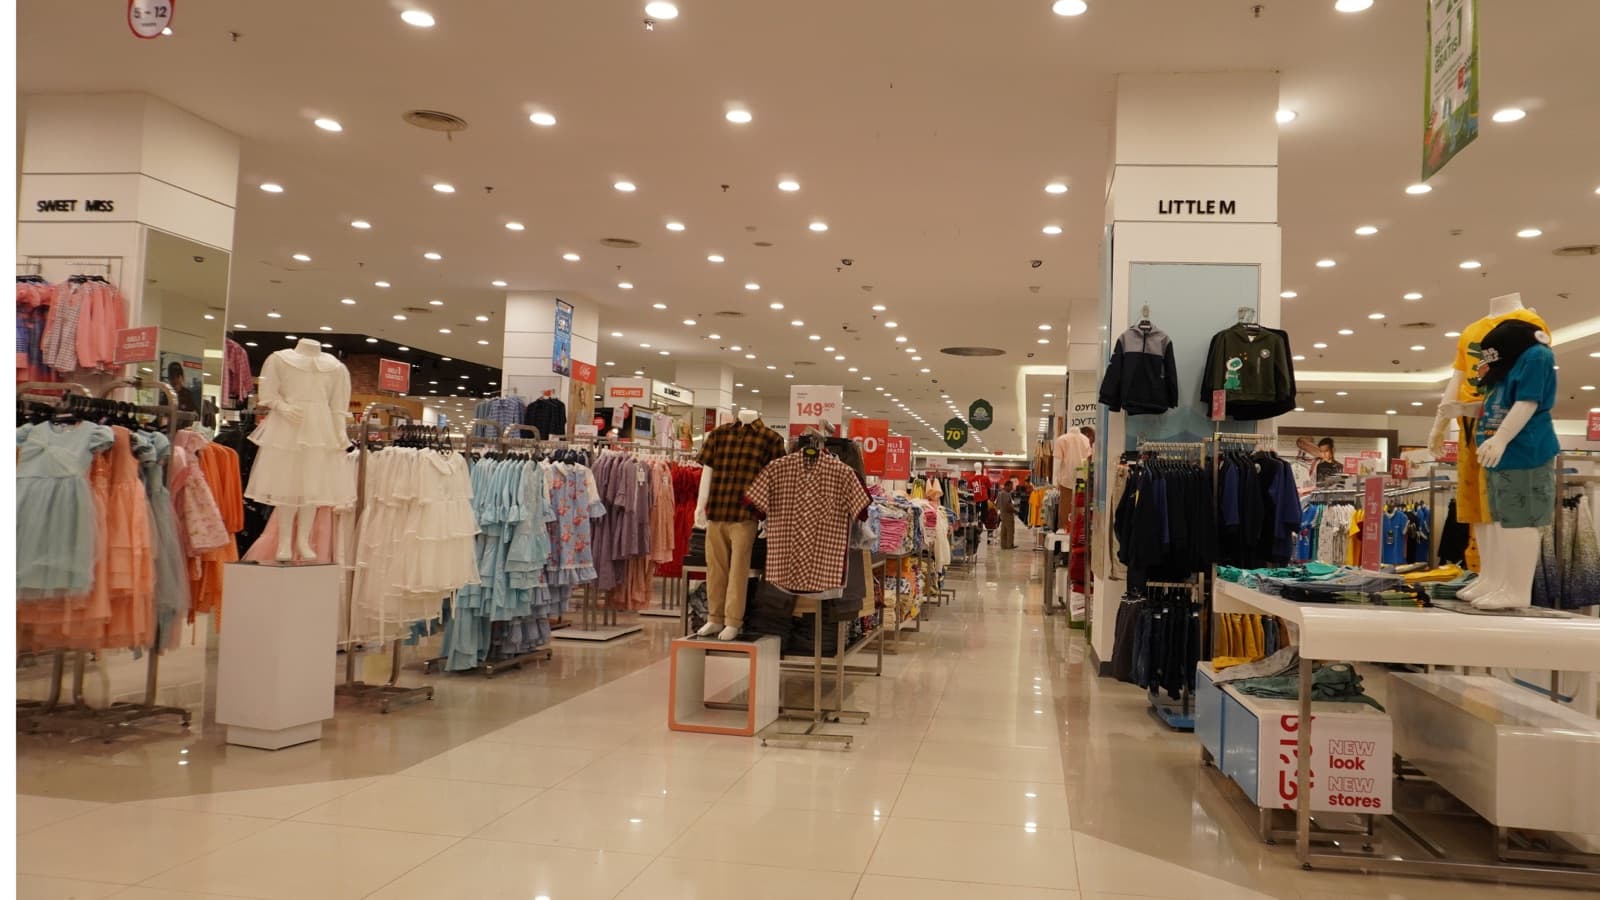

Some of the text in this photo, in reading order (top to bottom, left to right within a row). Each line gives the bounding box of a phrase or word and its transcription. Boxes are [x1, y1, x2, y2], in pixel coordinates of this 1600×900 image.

[154, 6, 167, 18] 12
[37, 200, 114, 212] SWEET MISS
[1159, 200, 1236, 214] LITTLE M
[797, 402, 822, 416] 149
[892, 453, 896, 464] 1
[1328, 739, 1375, 756] NEW
[1329, 756, 1365, 770] look
[1328, 776, 1374, 793] NEW
[1328, 794, 1382, 808] stores
